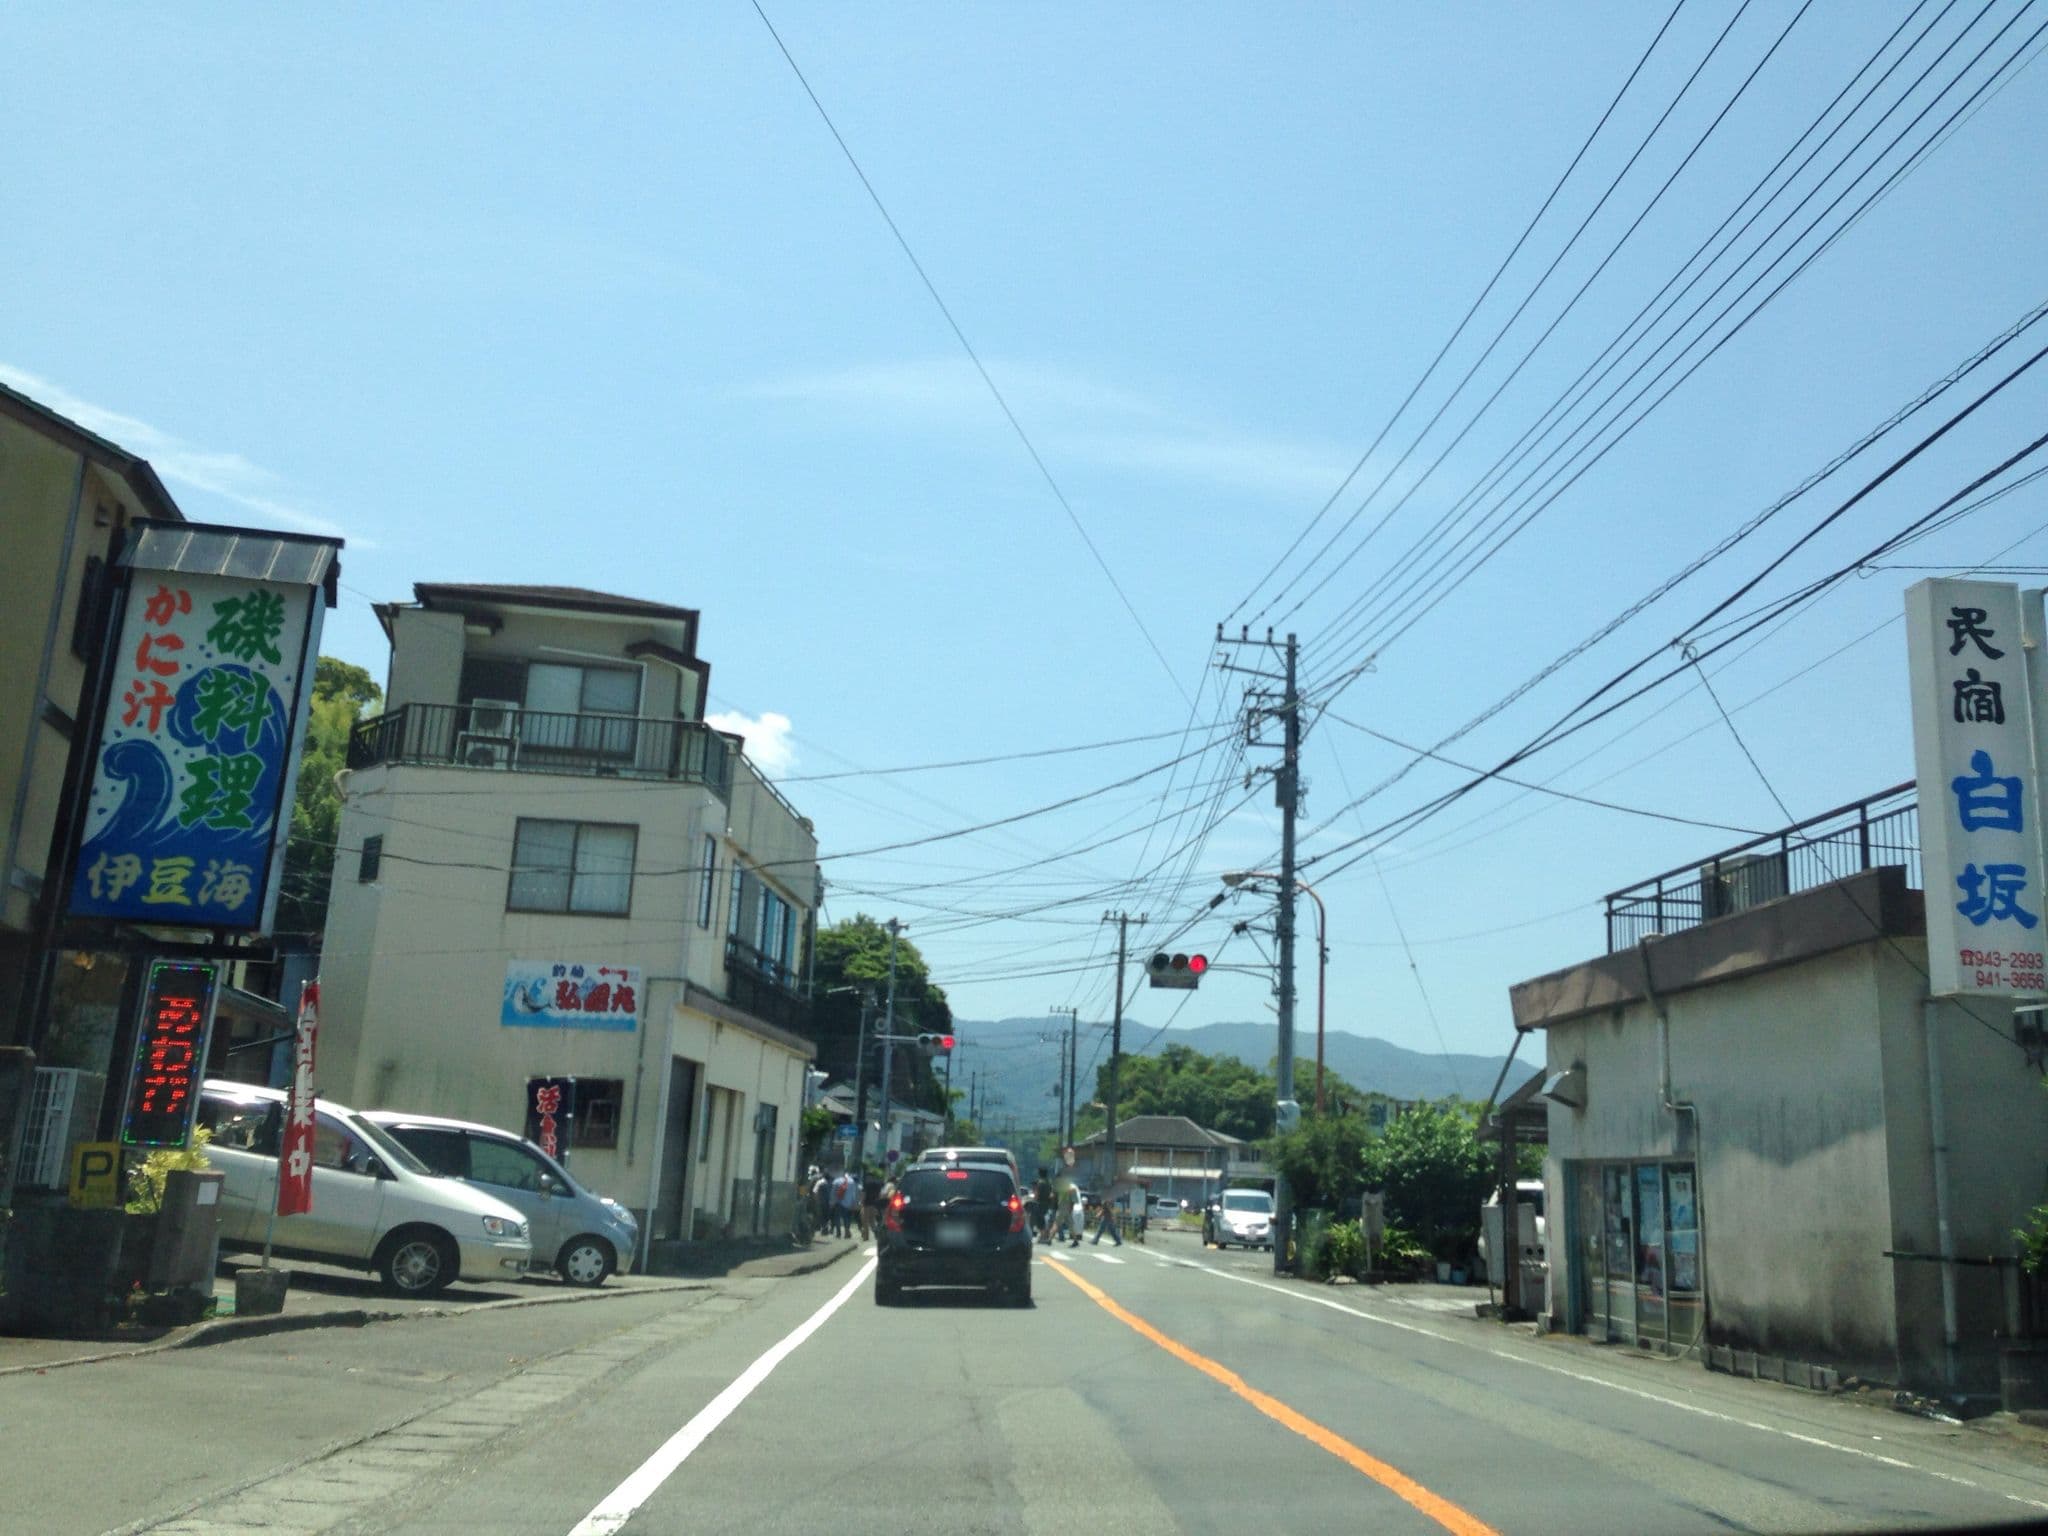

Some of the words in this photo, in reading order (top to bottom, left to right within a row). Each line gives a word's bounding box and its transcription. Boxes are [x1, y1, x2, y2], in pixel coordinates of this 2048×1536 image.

[122, 584, 192, 734] かに汁
[178, 587, 286, 830] 磯料理
[1947, 606, 2005, 725] 民宿
[87, 852, 254, 911] 伊豆海
[1952, 749, 2039, 930] 白坂
[1974, 951, 2044, 969] 943-2993
[79, 1151, 114, 1189] P
